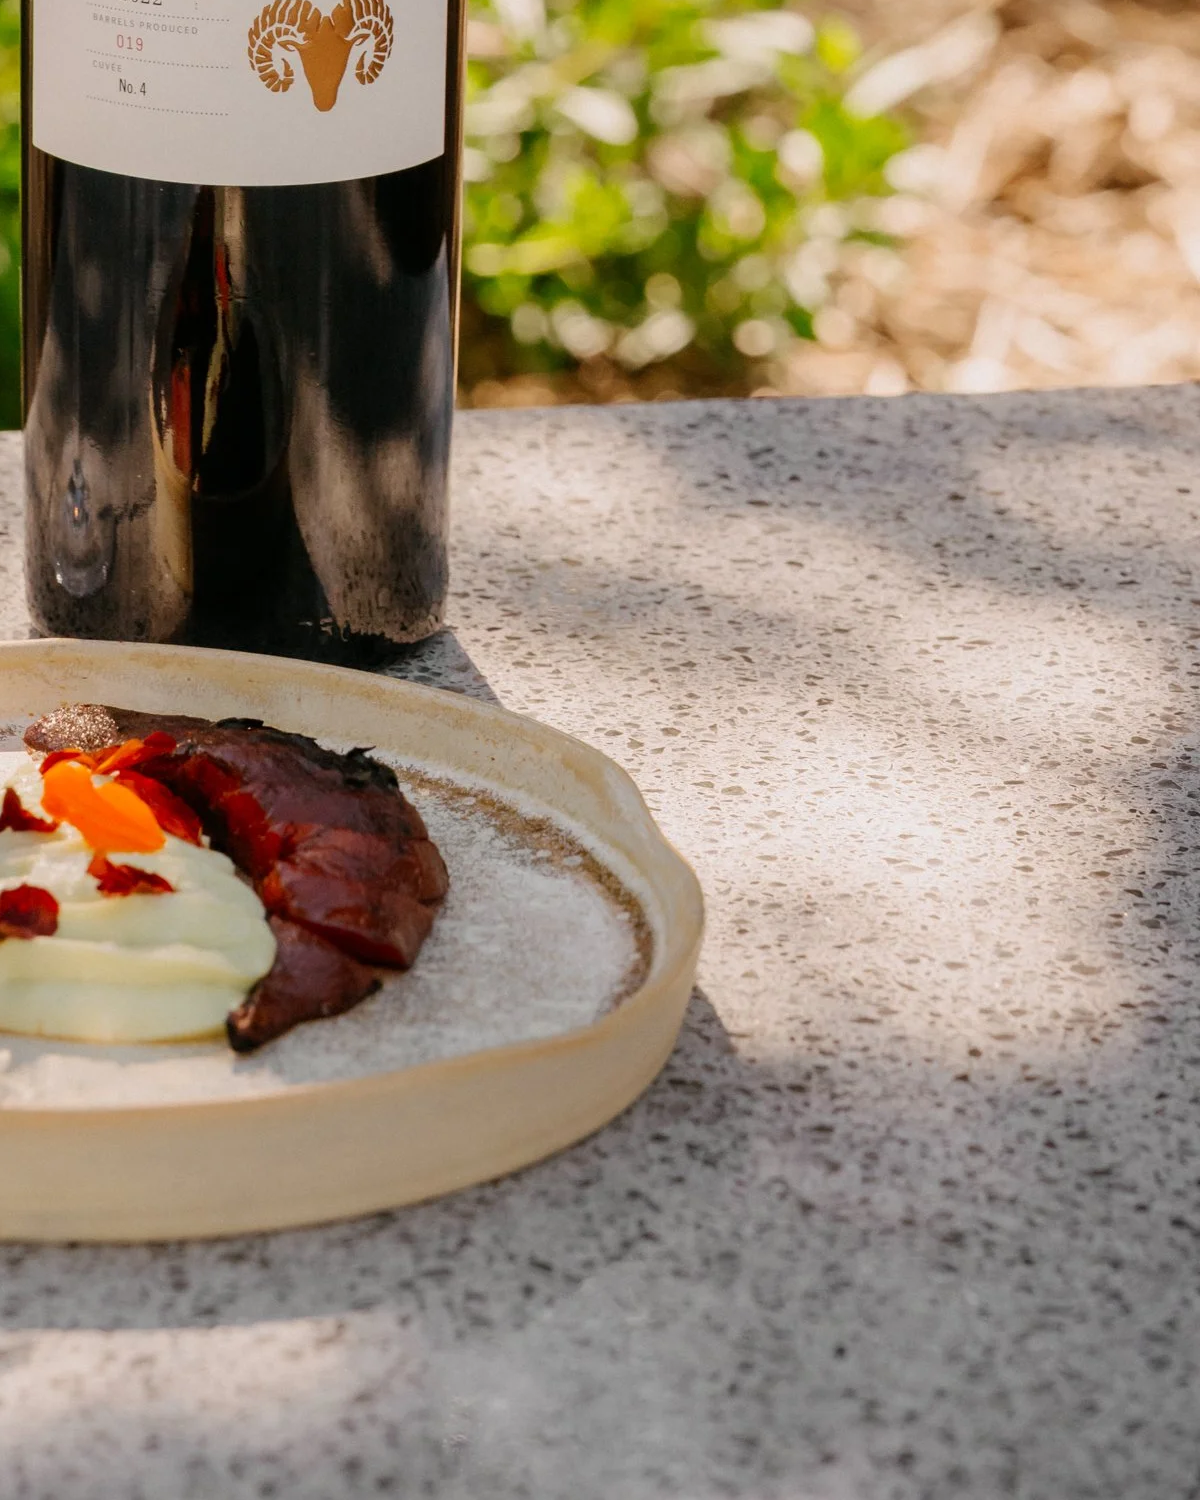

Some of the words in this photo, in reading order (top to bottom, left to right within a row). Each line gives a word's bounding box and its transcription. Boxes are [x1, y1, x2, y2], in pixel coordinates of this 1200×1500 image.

[93, 13, 135, 28] BARRELS
[139, 21, 199, 35] PRODUCED
[116, 34, 144, 52] 019
